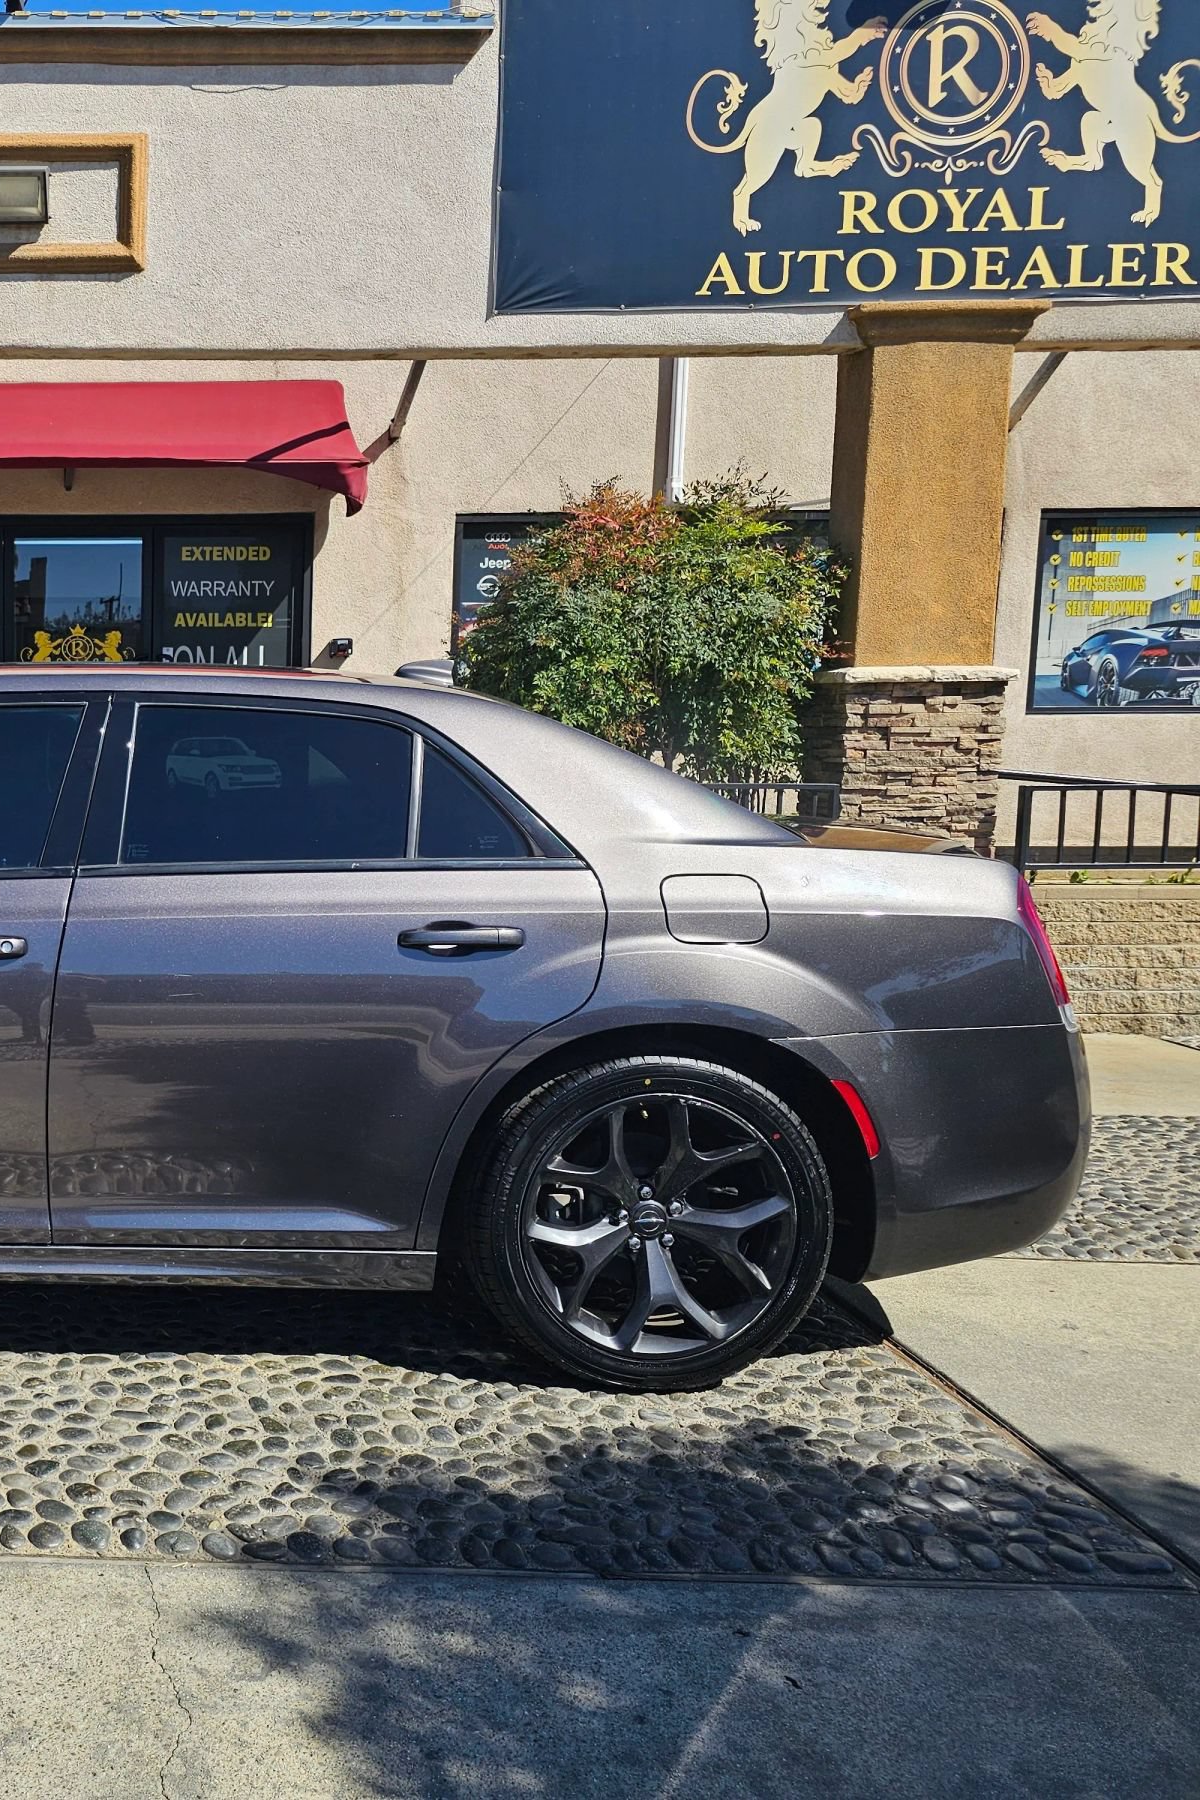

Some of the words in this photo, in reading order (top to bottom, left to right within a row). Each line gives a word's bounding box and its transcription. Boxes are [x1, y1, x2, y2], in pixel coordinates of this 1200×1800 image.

[925, 24, 989, 108] R
[836, 187, 1066, 235] ROYAL
[694, 247, 898, 296] AUTO
[914, 242, 1198, 291] DEALER
[1072, 527, 1089, 542] 1ST
[1090, 527, 1113, 542] TIME
[1115, 527, 1147, 542] BUYER
[181, 546, 271, 561] EXTENDED
[1069, 551, 1083, 567] NO
[1085, 551, 1120, 567] CREDIT
[480, 557, 511, 570] Jeep
[170, 580, 275, 597] WARRANTY
[1067, 575, 1147, 592] REPOSSESSIONS
[1065, 599, 1086, 616] SELF
[1087, 599, 1153, 616] EMPLOYMENT
[174, 612, 273, 628] AVAILABLE!
[72, 640, 85, 656] R
